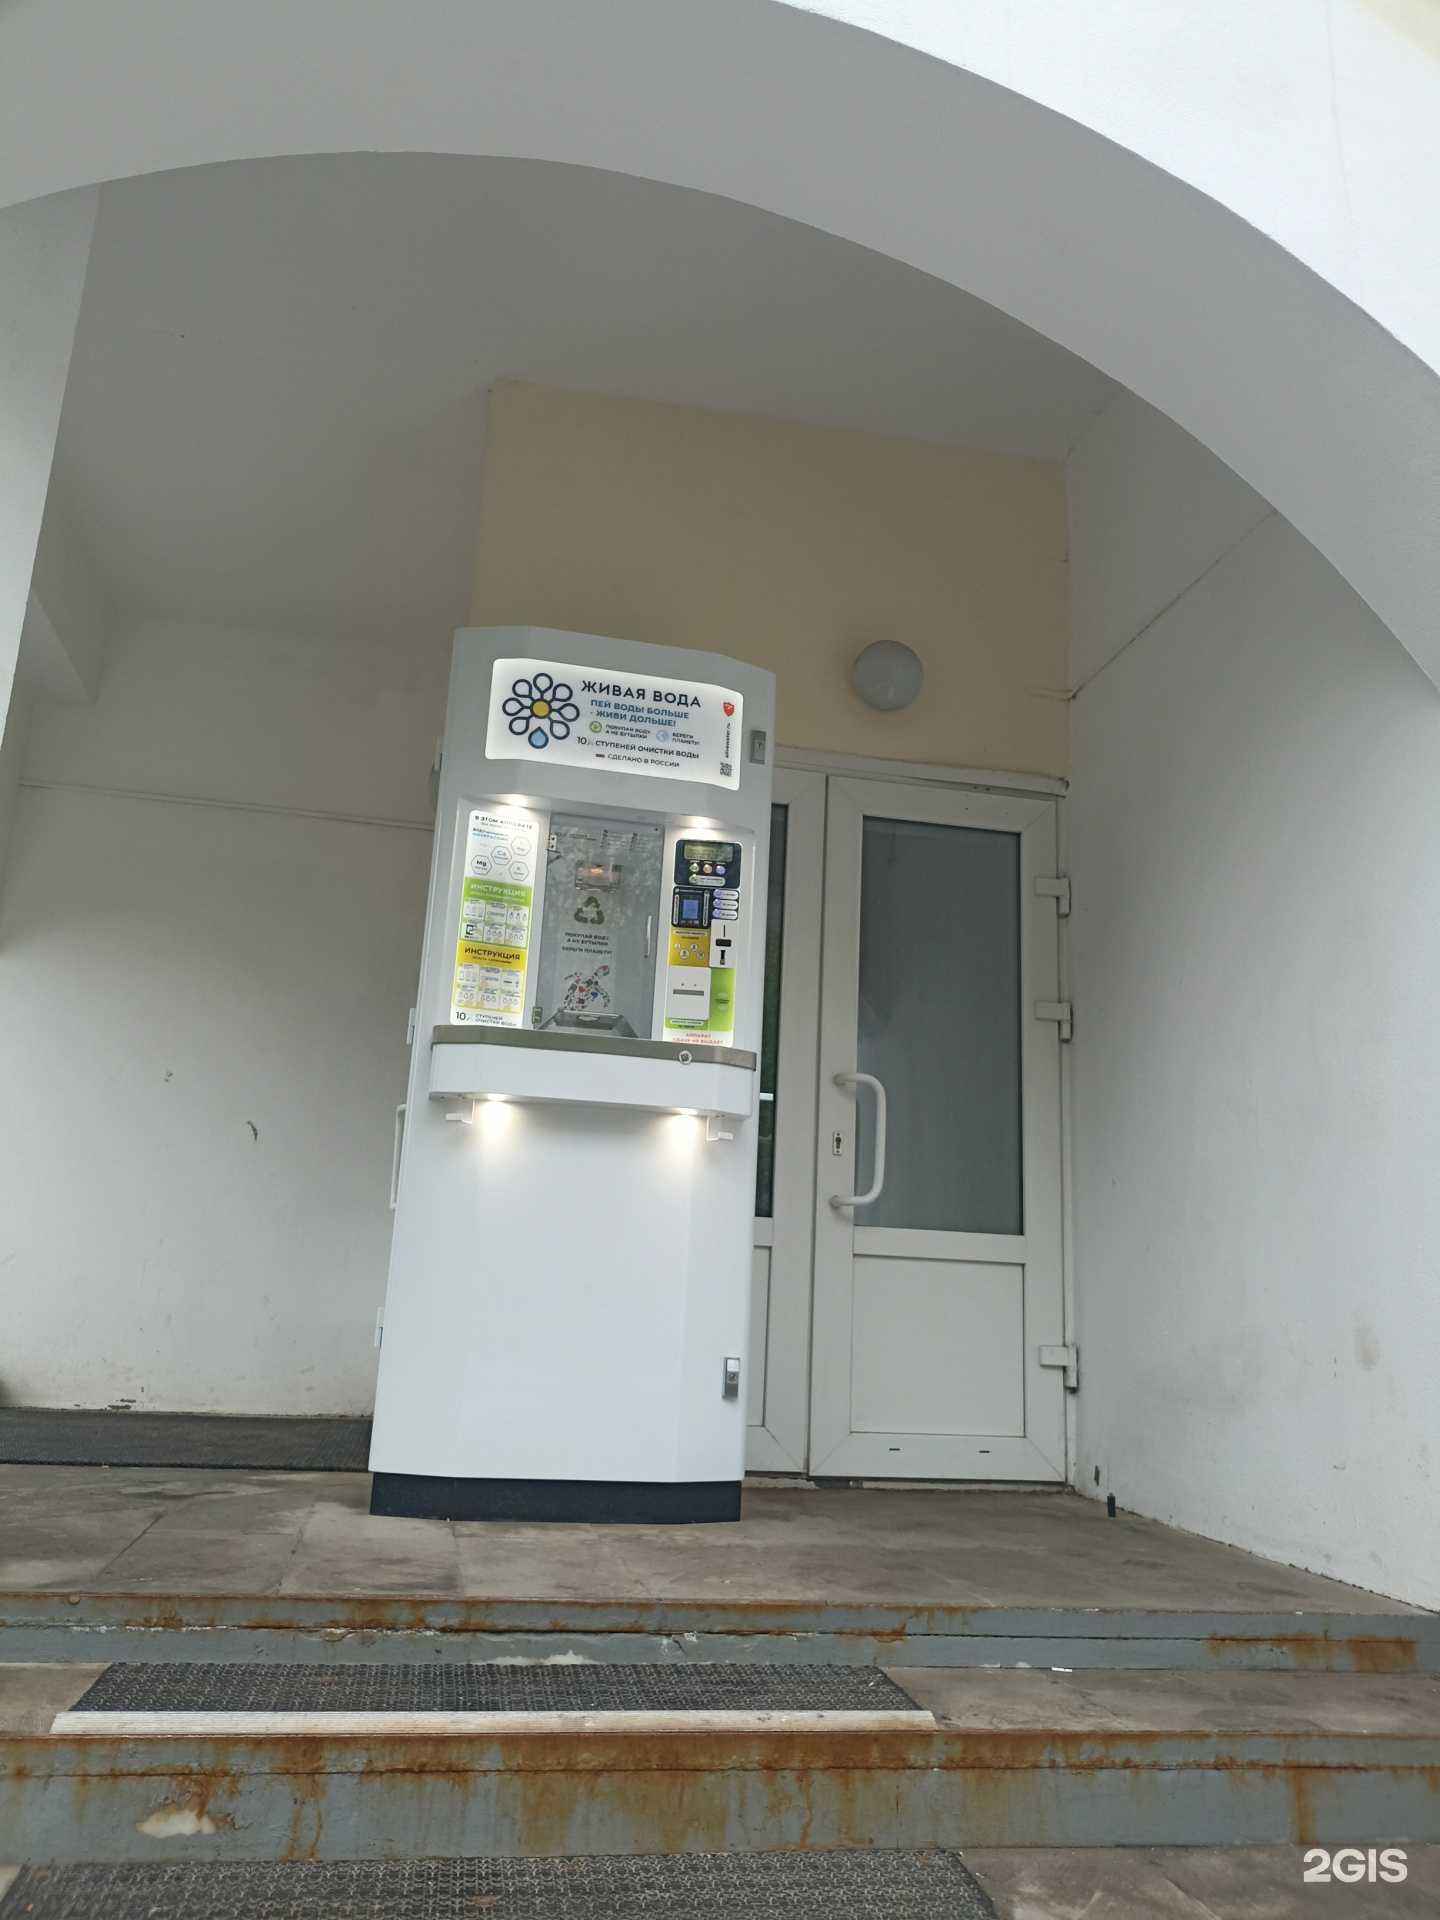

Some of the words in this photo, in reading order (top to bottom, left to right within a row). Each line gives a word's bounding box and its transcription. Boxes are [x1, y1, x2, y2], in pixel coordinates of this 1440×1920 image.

[581, 680, 646, 700] ЖИВАЯ
[652, 690, 701, 708] ВОДА
[590, 699, 611, 709] ПЕЙ
[613, 702, 645, 713] ВОДЫ
[646, 706, 689, 719] БОЛЬШЕ
[596, 710, 627, 721] ЖИВИ
[629, 714, 676, 727] ДОЛЬШЕ!
[577, 736, 587, 745] 10
[595, 740, 635, 751] СТУПЕНЕЙ
[637, 745, 674, 756] ОЧИСТКИ
[675, 750, 699, 759] ВОДЫ
[607, 753, 642, 764] СДЕЛАНО
[650, 759, 680, 768] РОССИИ
[476, 860, 487, 868] Mg
[470, 883, 528, 897] ИНСТРУКЦИЯ
[464, 946, 520, 961] ИНСТРУКЦИЯ
[456, 1011, 466, 1021] 10
